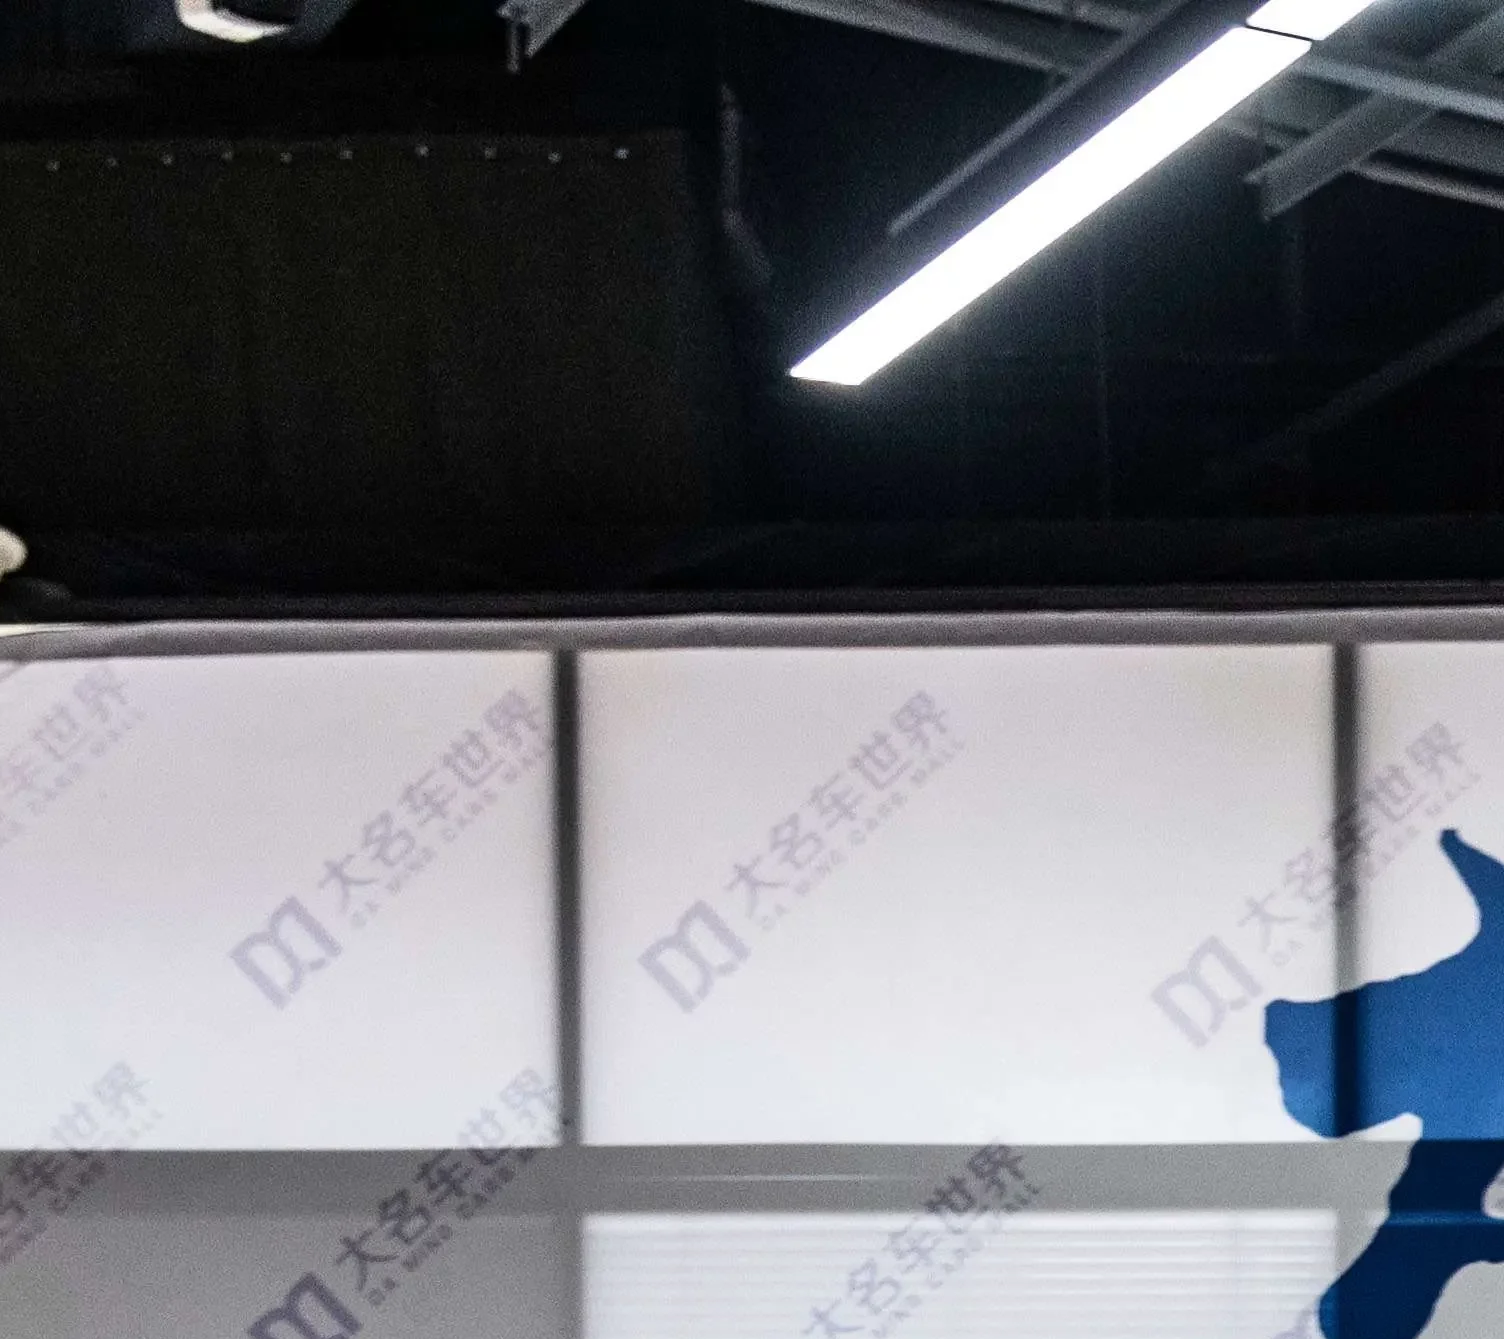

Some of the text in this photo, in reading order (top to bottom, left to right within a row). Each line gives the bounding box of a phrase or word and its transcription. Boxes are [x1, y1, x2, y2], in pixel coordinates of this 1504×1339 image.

[318, 688, 539, 914] 大名车世界
[726, 689, 950, 917] 大名车世界
[335, 1068, 561, 1290] 大名车世界
